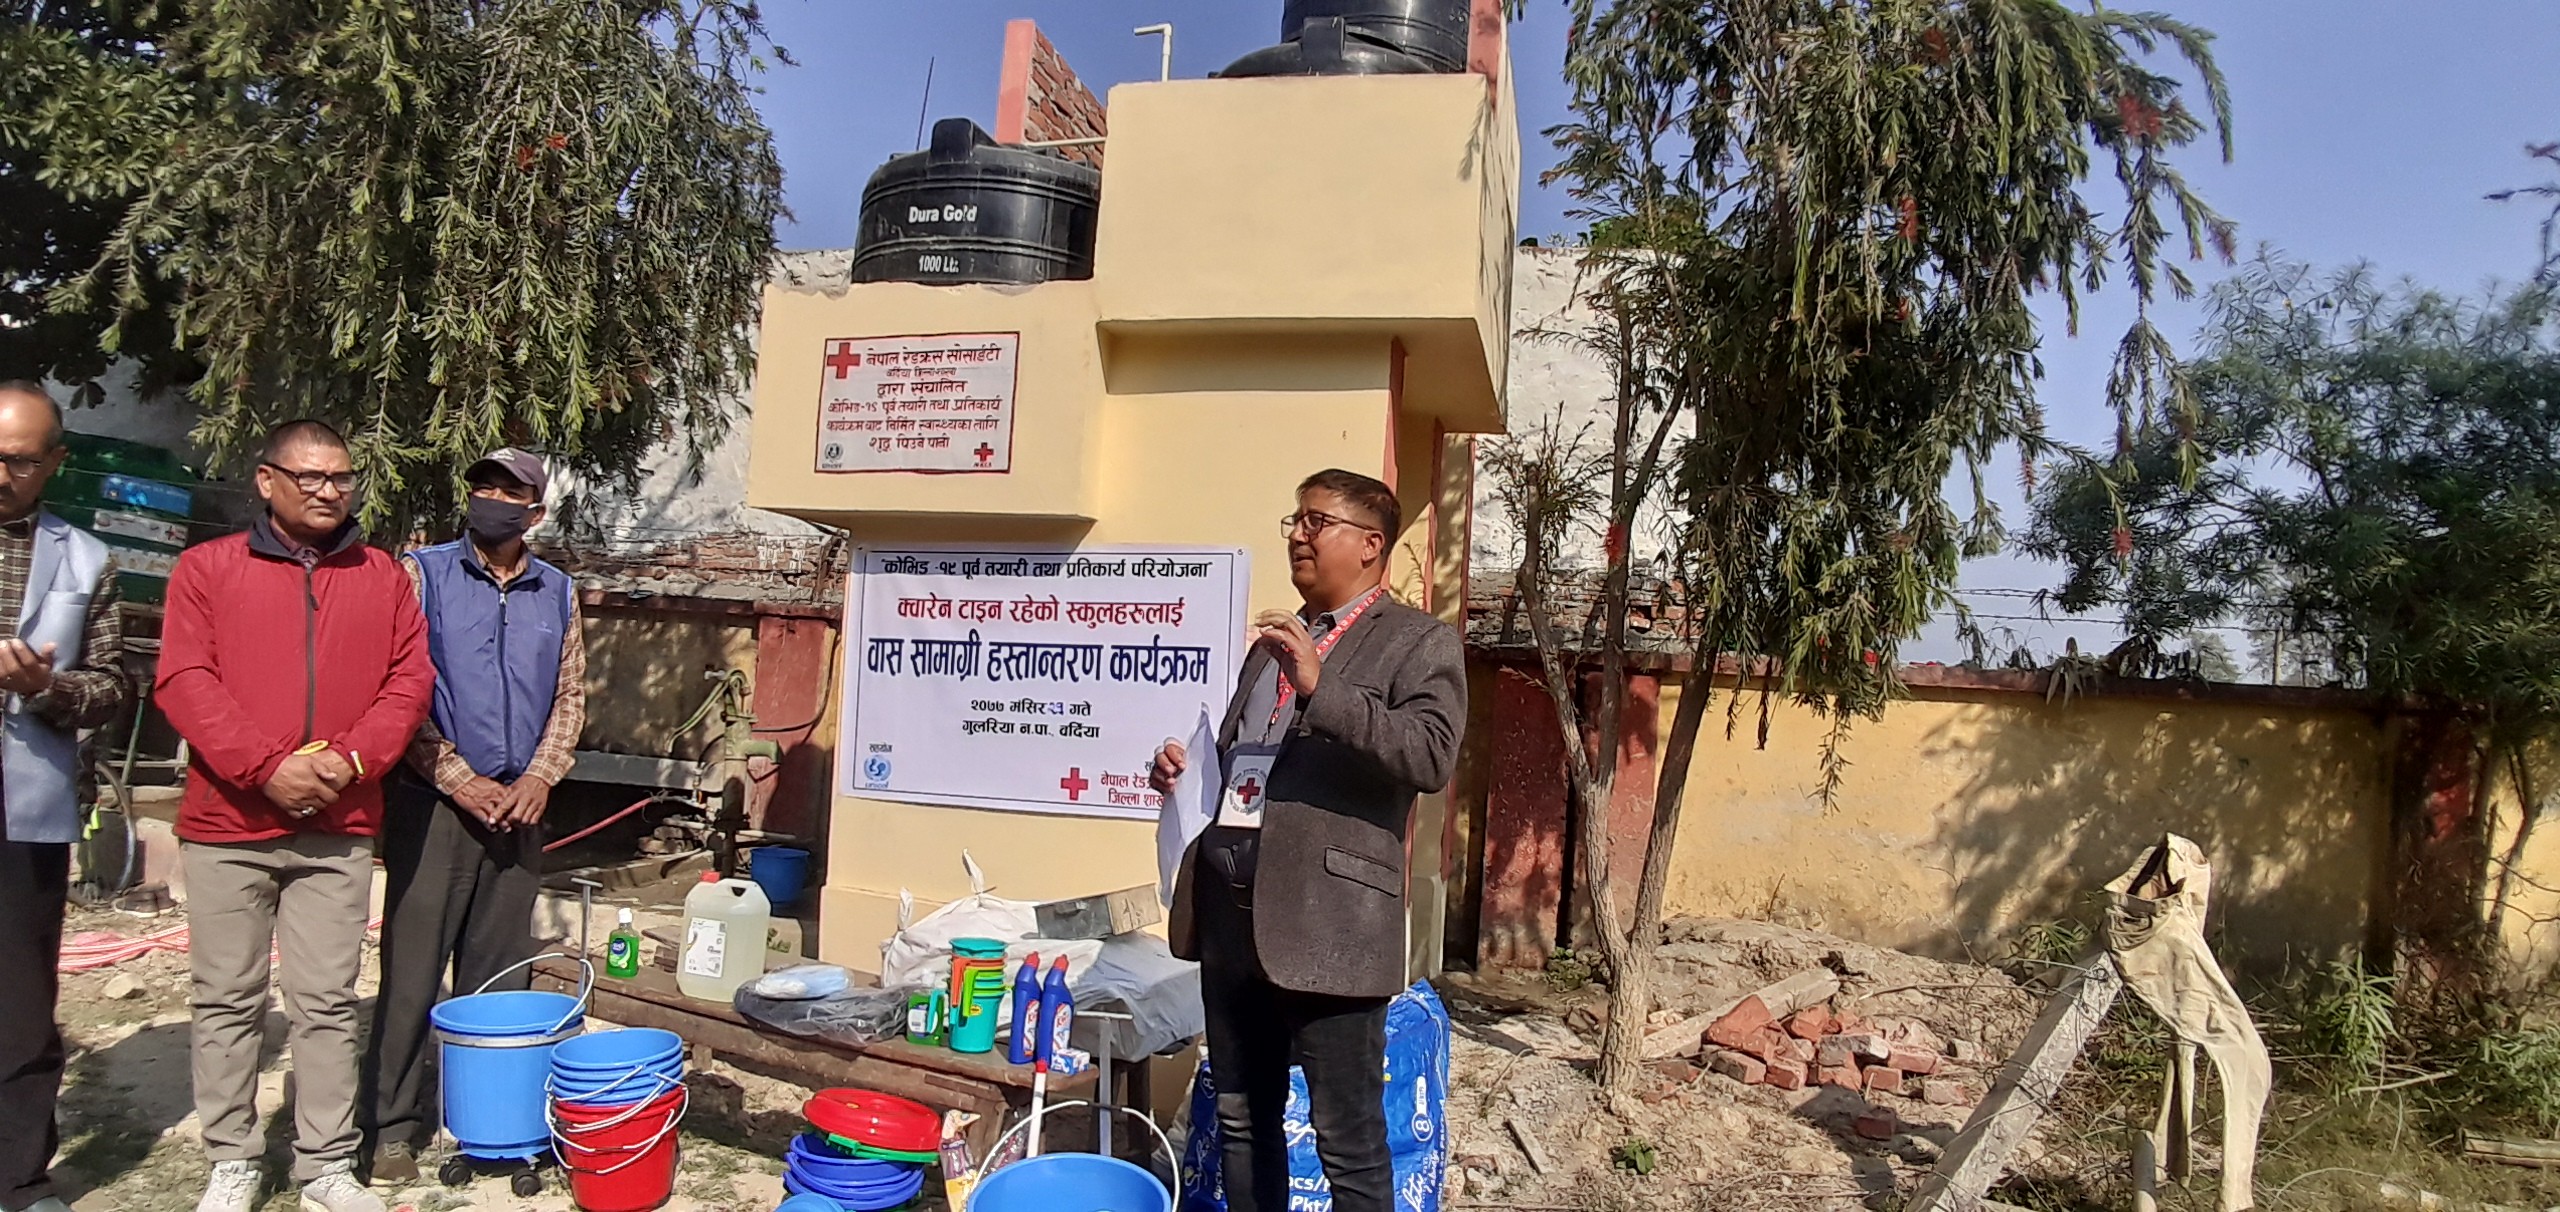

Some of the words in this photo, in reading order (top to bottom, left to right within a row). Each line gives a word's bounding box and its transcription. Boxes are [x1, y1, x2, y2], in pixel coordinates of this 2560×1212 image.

[909, 205, 939, 223] Dura
[918, 255, 941, 273] 1000
[866, 348, 900, 366] नेपाल
[902, 345, 944, 368] रेडक्रस
[877, 382, 905, 399] द्वारा
[910, 377, 968, 396] संचालित
[929, 398, 950, 412] तथा
[962, 557, 981, 580] पूर्व
[984, 557, 1029, 577] तयारी
[1032, 562, 1062, 577] तथा
[1066, 557, 1126, 579] प्रतिकार्य
[898, 592, 953, 619] क्वारेन
[958, 599, 1004, 624] टाइन
[1009, 594, 1059, 624] रहेको
[867, 637, 904, 676] वास
[911, 628, 982, 683] सामाग्री
[987, 641, 1103, 683] हस्तान्तरण
[1110, 633, 1211, 685] कार्यक्रम
[971, 699, 1004, 713] २०७७
[1010, 697, 1047, 715] मंसिर
[1069, 700, 1092, 717] गते
[962, 717, 1015, 736] गुलरिया
[1059, 721, 1100, 738] वर्दिया
[1100, 769, 1129, 788] नेपाल
[1132, 772, 1151, 789] रेड
[1108, 787, 1140, 806] जिल्ला
